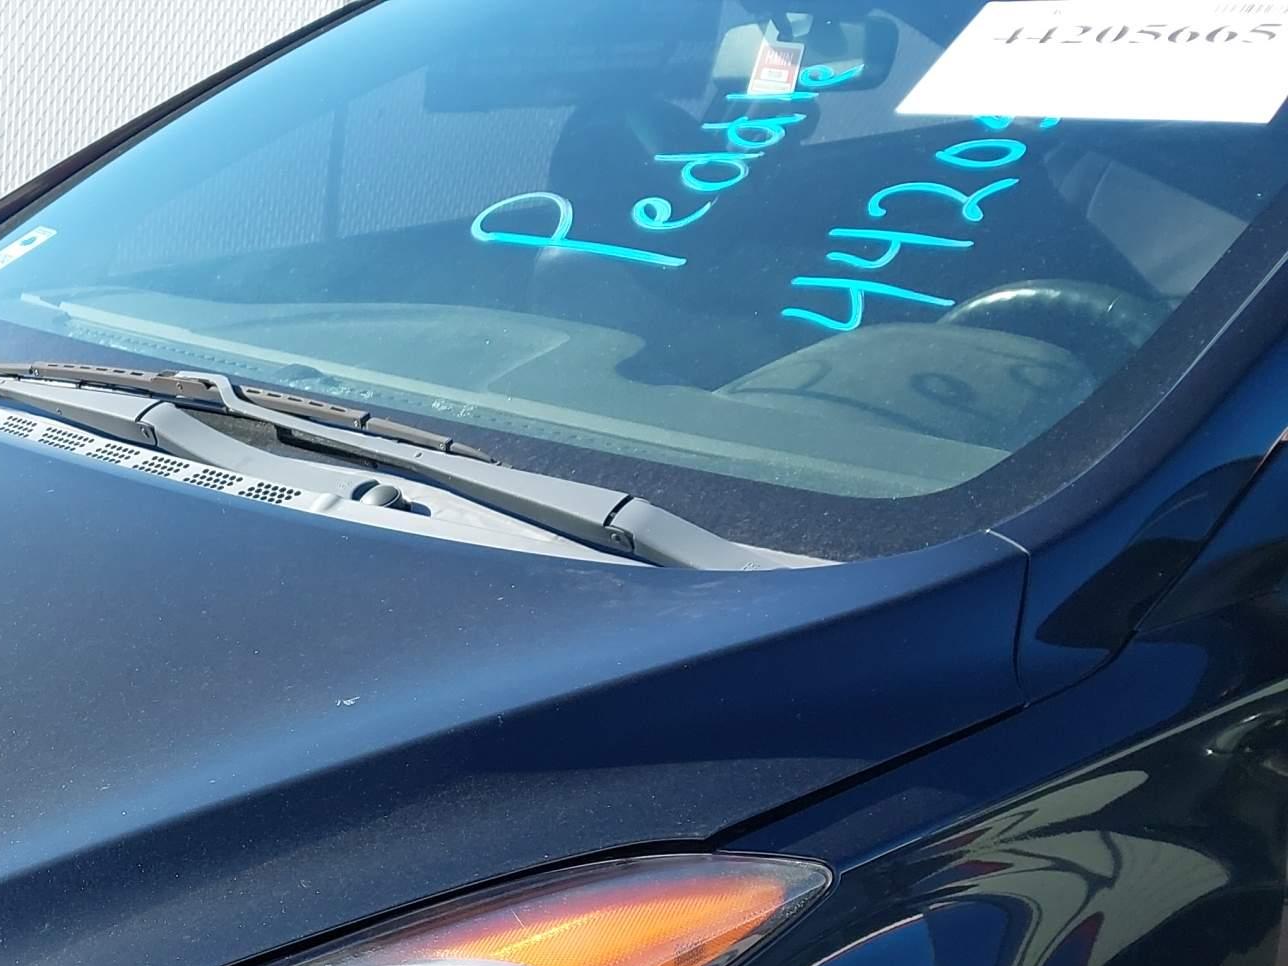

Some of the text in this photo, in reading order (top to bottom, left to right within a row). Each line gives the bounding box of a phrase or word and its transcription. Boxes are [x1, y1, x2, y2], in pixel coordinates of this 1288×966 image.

[993, 23, 1283, 45] 44205665
[471, 63, 865, 268] Peddle
[781, 115, 1061, 331] 4420
